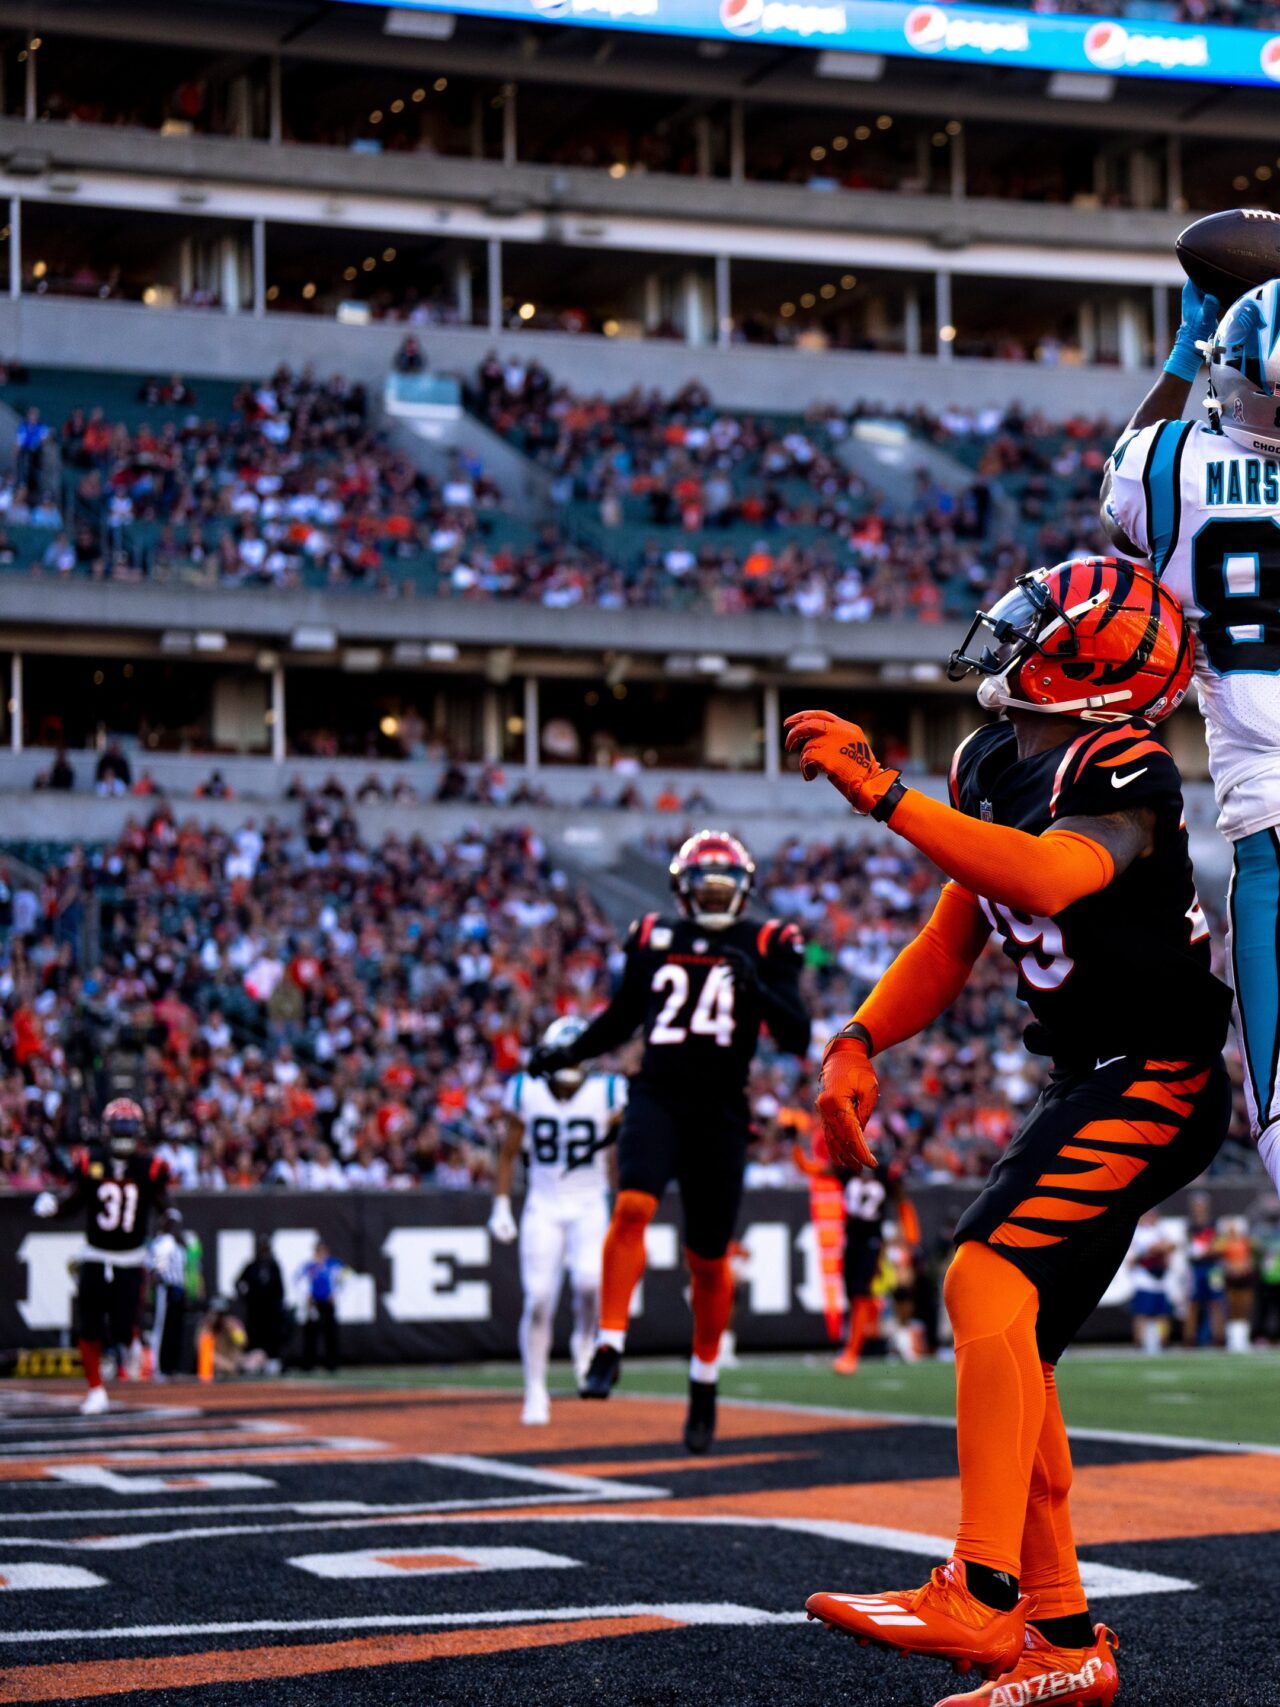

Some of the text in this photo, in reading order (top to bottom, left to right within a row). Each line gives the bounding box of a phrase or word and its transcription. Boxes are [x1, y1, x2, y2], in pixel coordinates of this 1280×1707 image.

[648, 963, 737, 1048] 24
[532, 1117, 597, 1168] 82
[96, 1181, 139, 1233] 31
